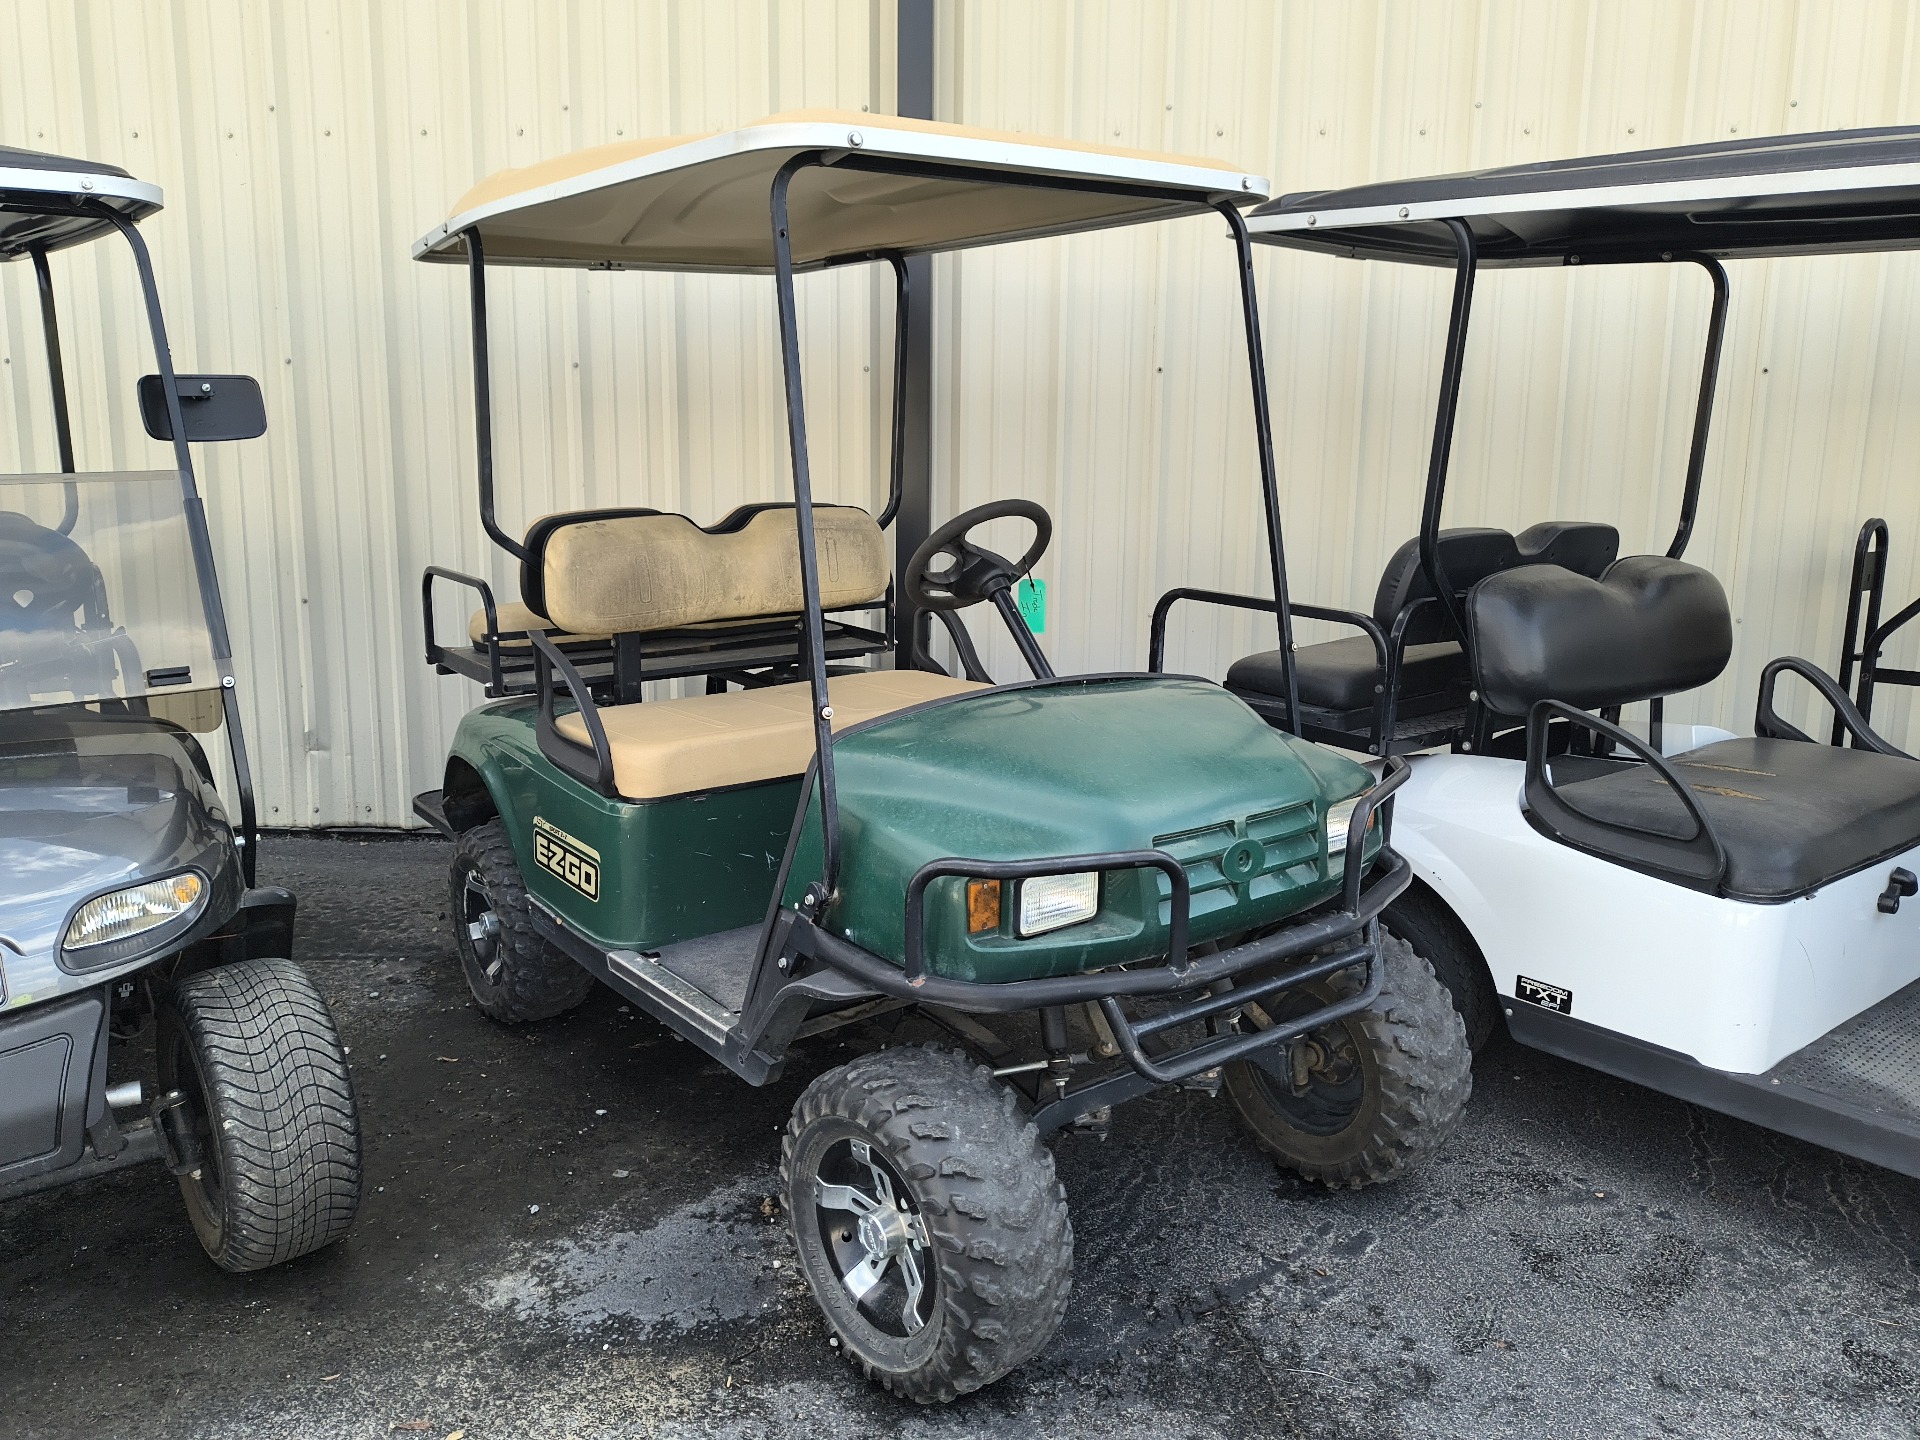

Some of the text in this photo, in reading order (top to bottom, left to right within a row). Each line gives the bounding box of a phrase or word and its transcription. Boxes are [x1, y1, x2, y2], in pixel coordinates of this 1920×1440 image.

[1521, 978, 1568, 996] FREEDOM
[1521, 983, 1568, 1005] TXT
[1541, 1000, 1560, 1010] EFI
